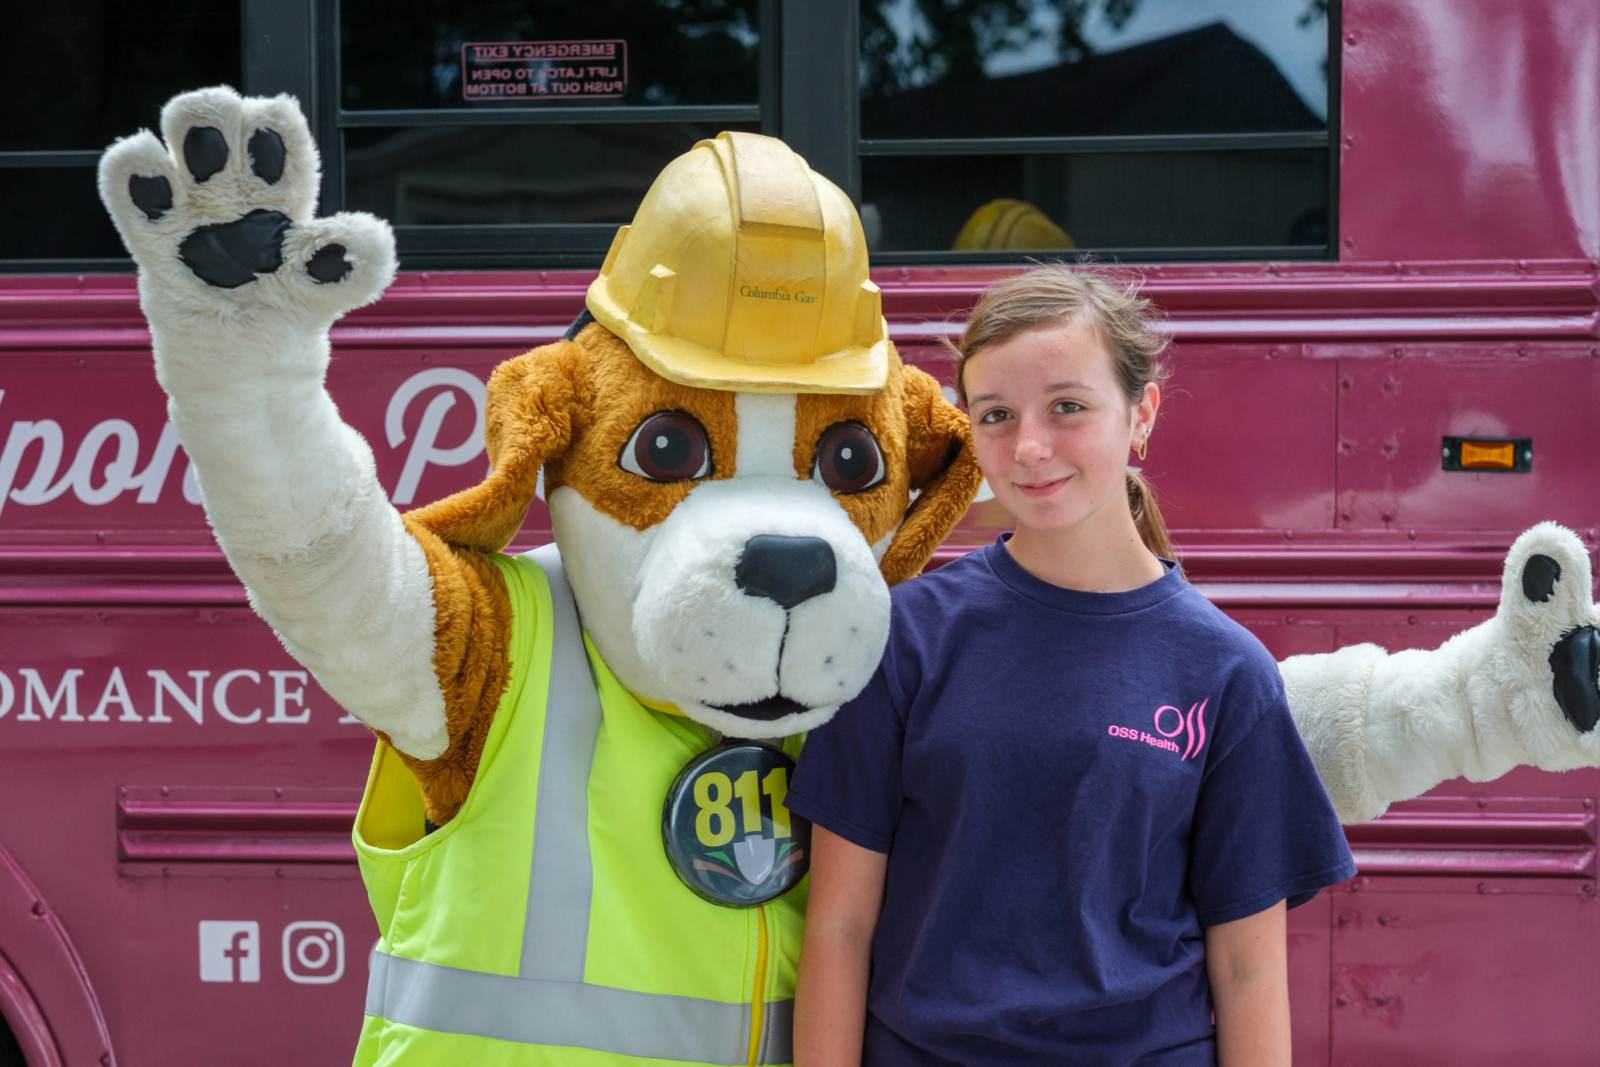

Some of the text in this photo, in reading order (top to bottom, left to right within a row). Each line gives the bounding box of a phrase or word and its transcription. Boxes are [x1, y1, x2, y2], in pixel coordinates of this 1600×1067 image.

[740, 285, 818, 303] Columbia Gas
[0, 667, 310, 725] MANCE
[1108, 724, 1179, 753] OSS Health
[693, 767, 792, 847] 811
